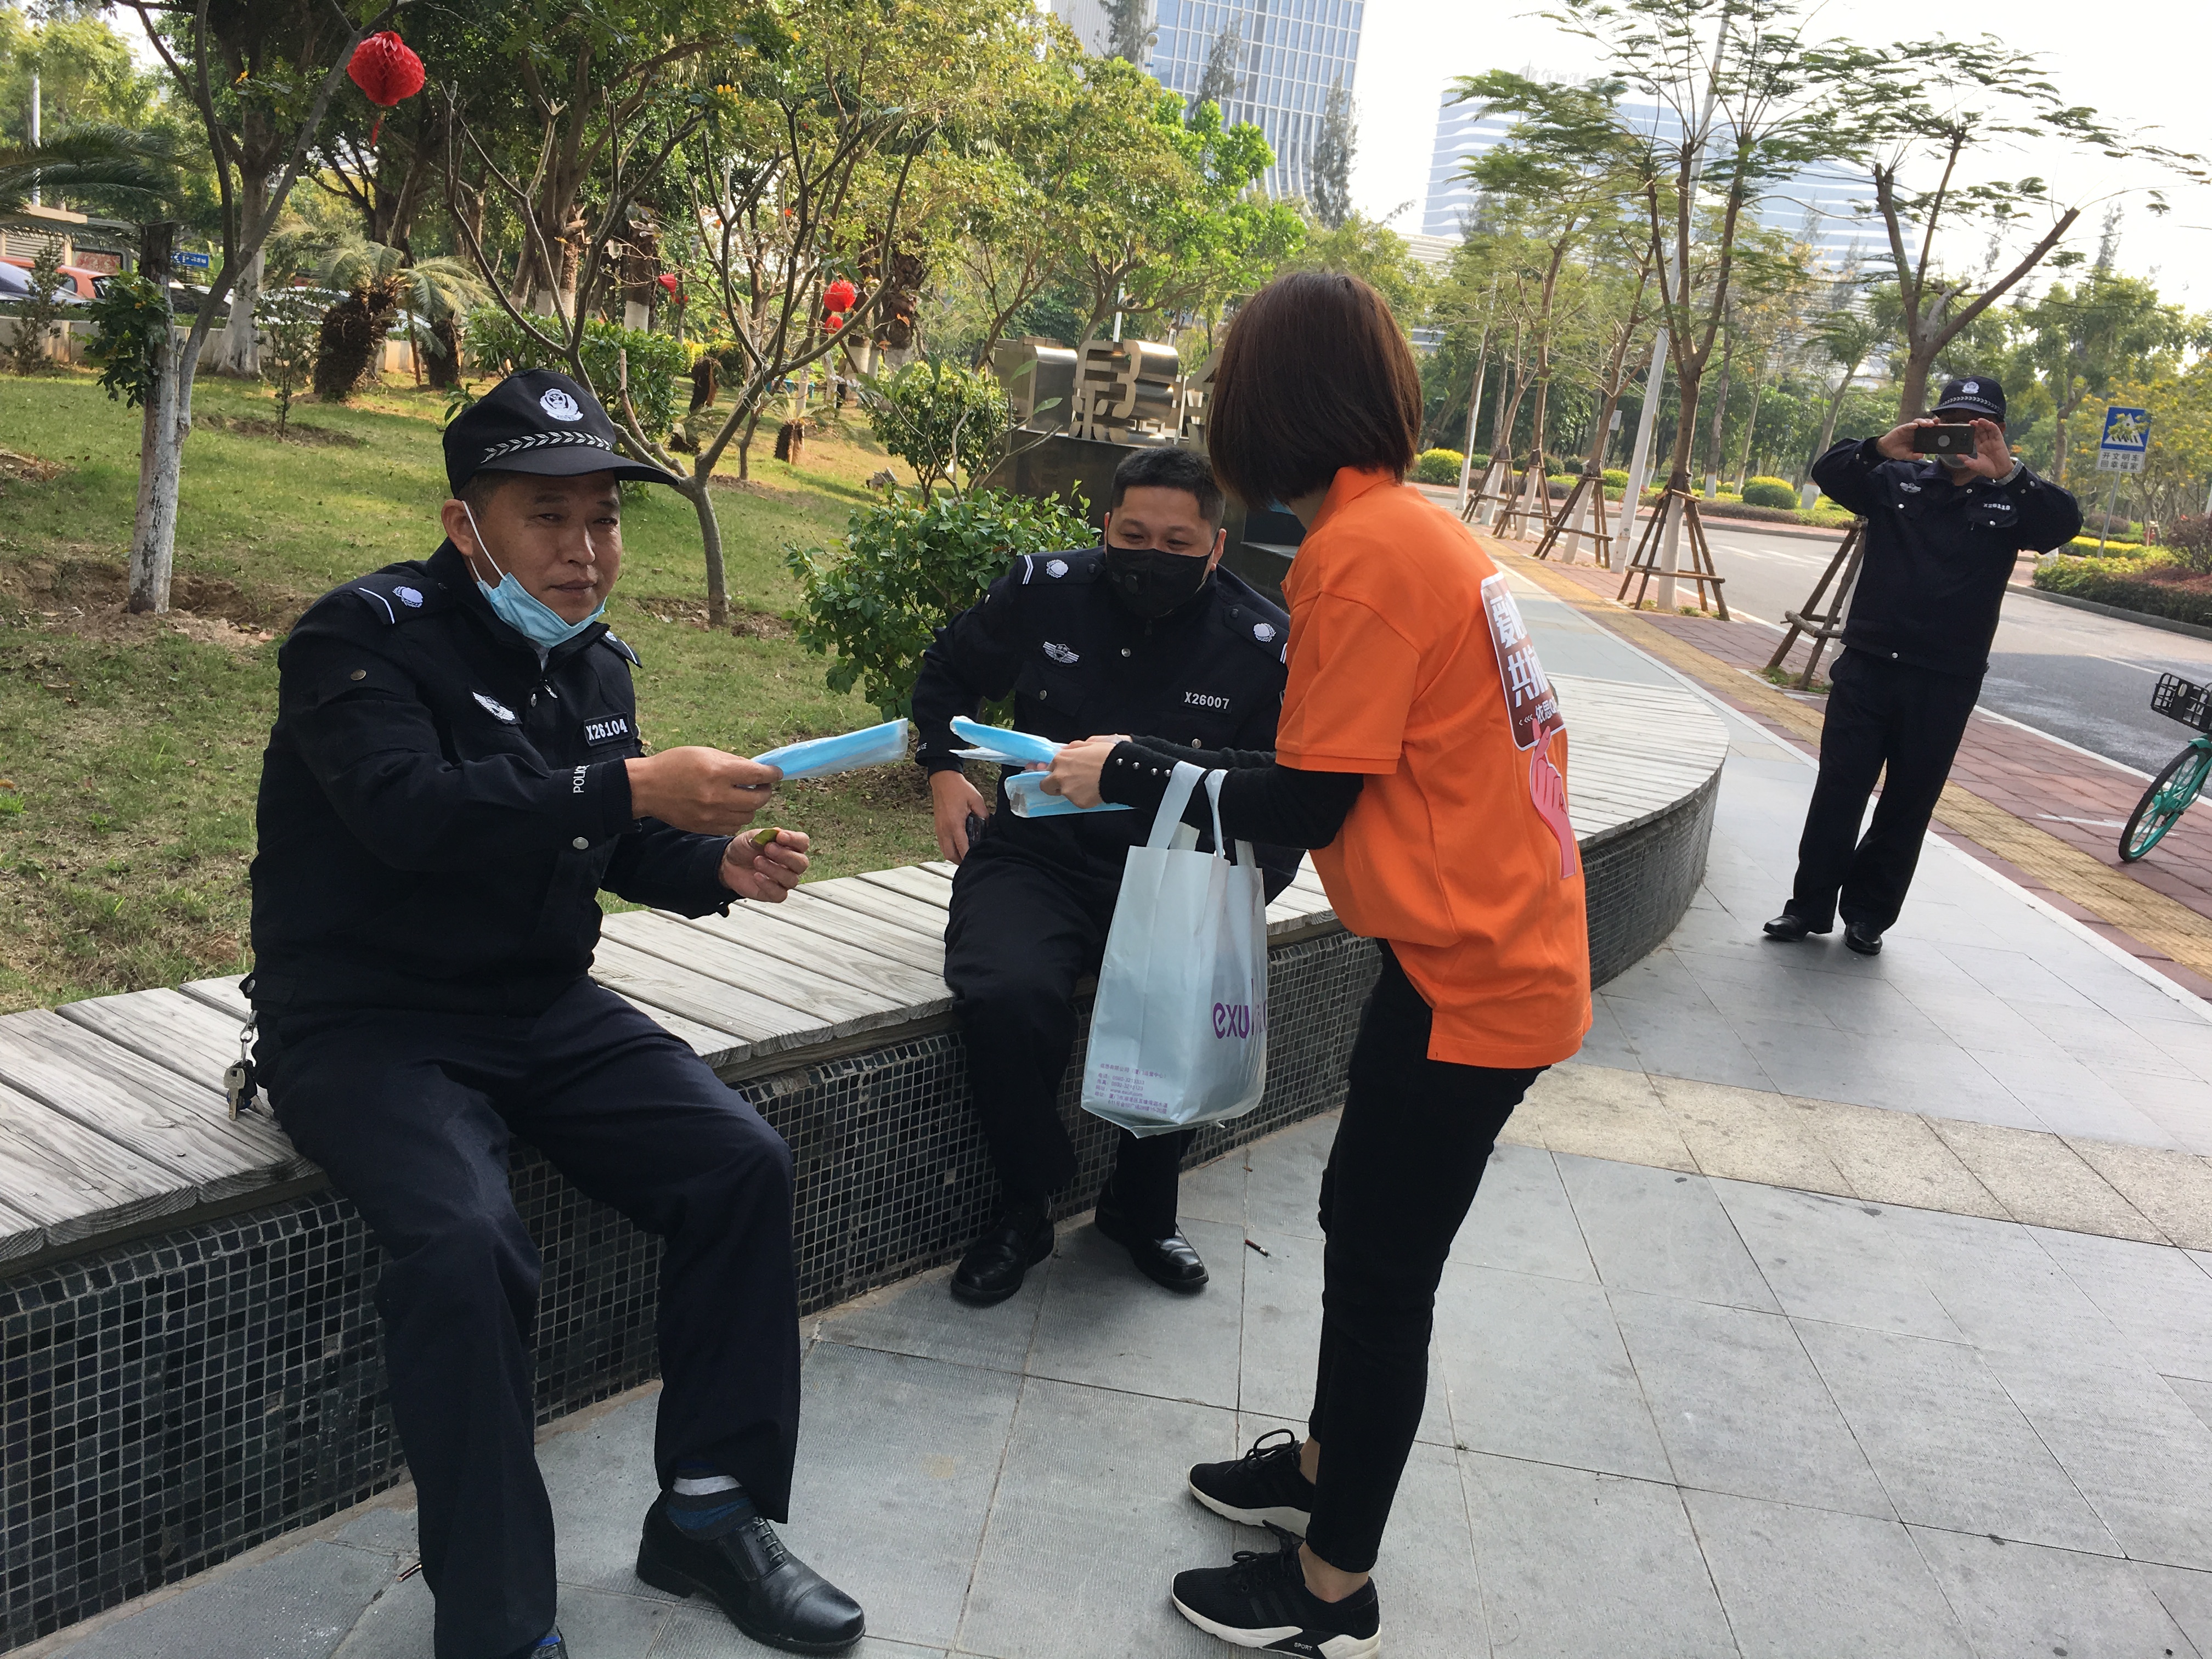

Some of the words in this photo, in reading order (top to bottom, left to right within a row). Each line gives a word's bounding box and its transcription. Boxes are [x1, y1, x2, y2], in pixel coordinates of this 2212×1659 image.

[2102, 452, 2140, 461] 开文明车
[2101, 460, 2138, 470] 回幸福家
[1184, 691, 1230, 710] X26007
[585, 718, 628, 741] X26104
[1294, 1642, 1313, 1651] SPORT
